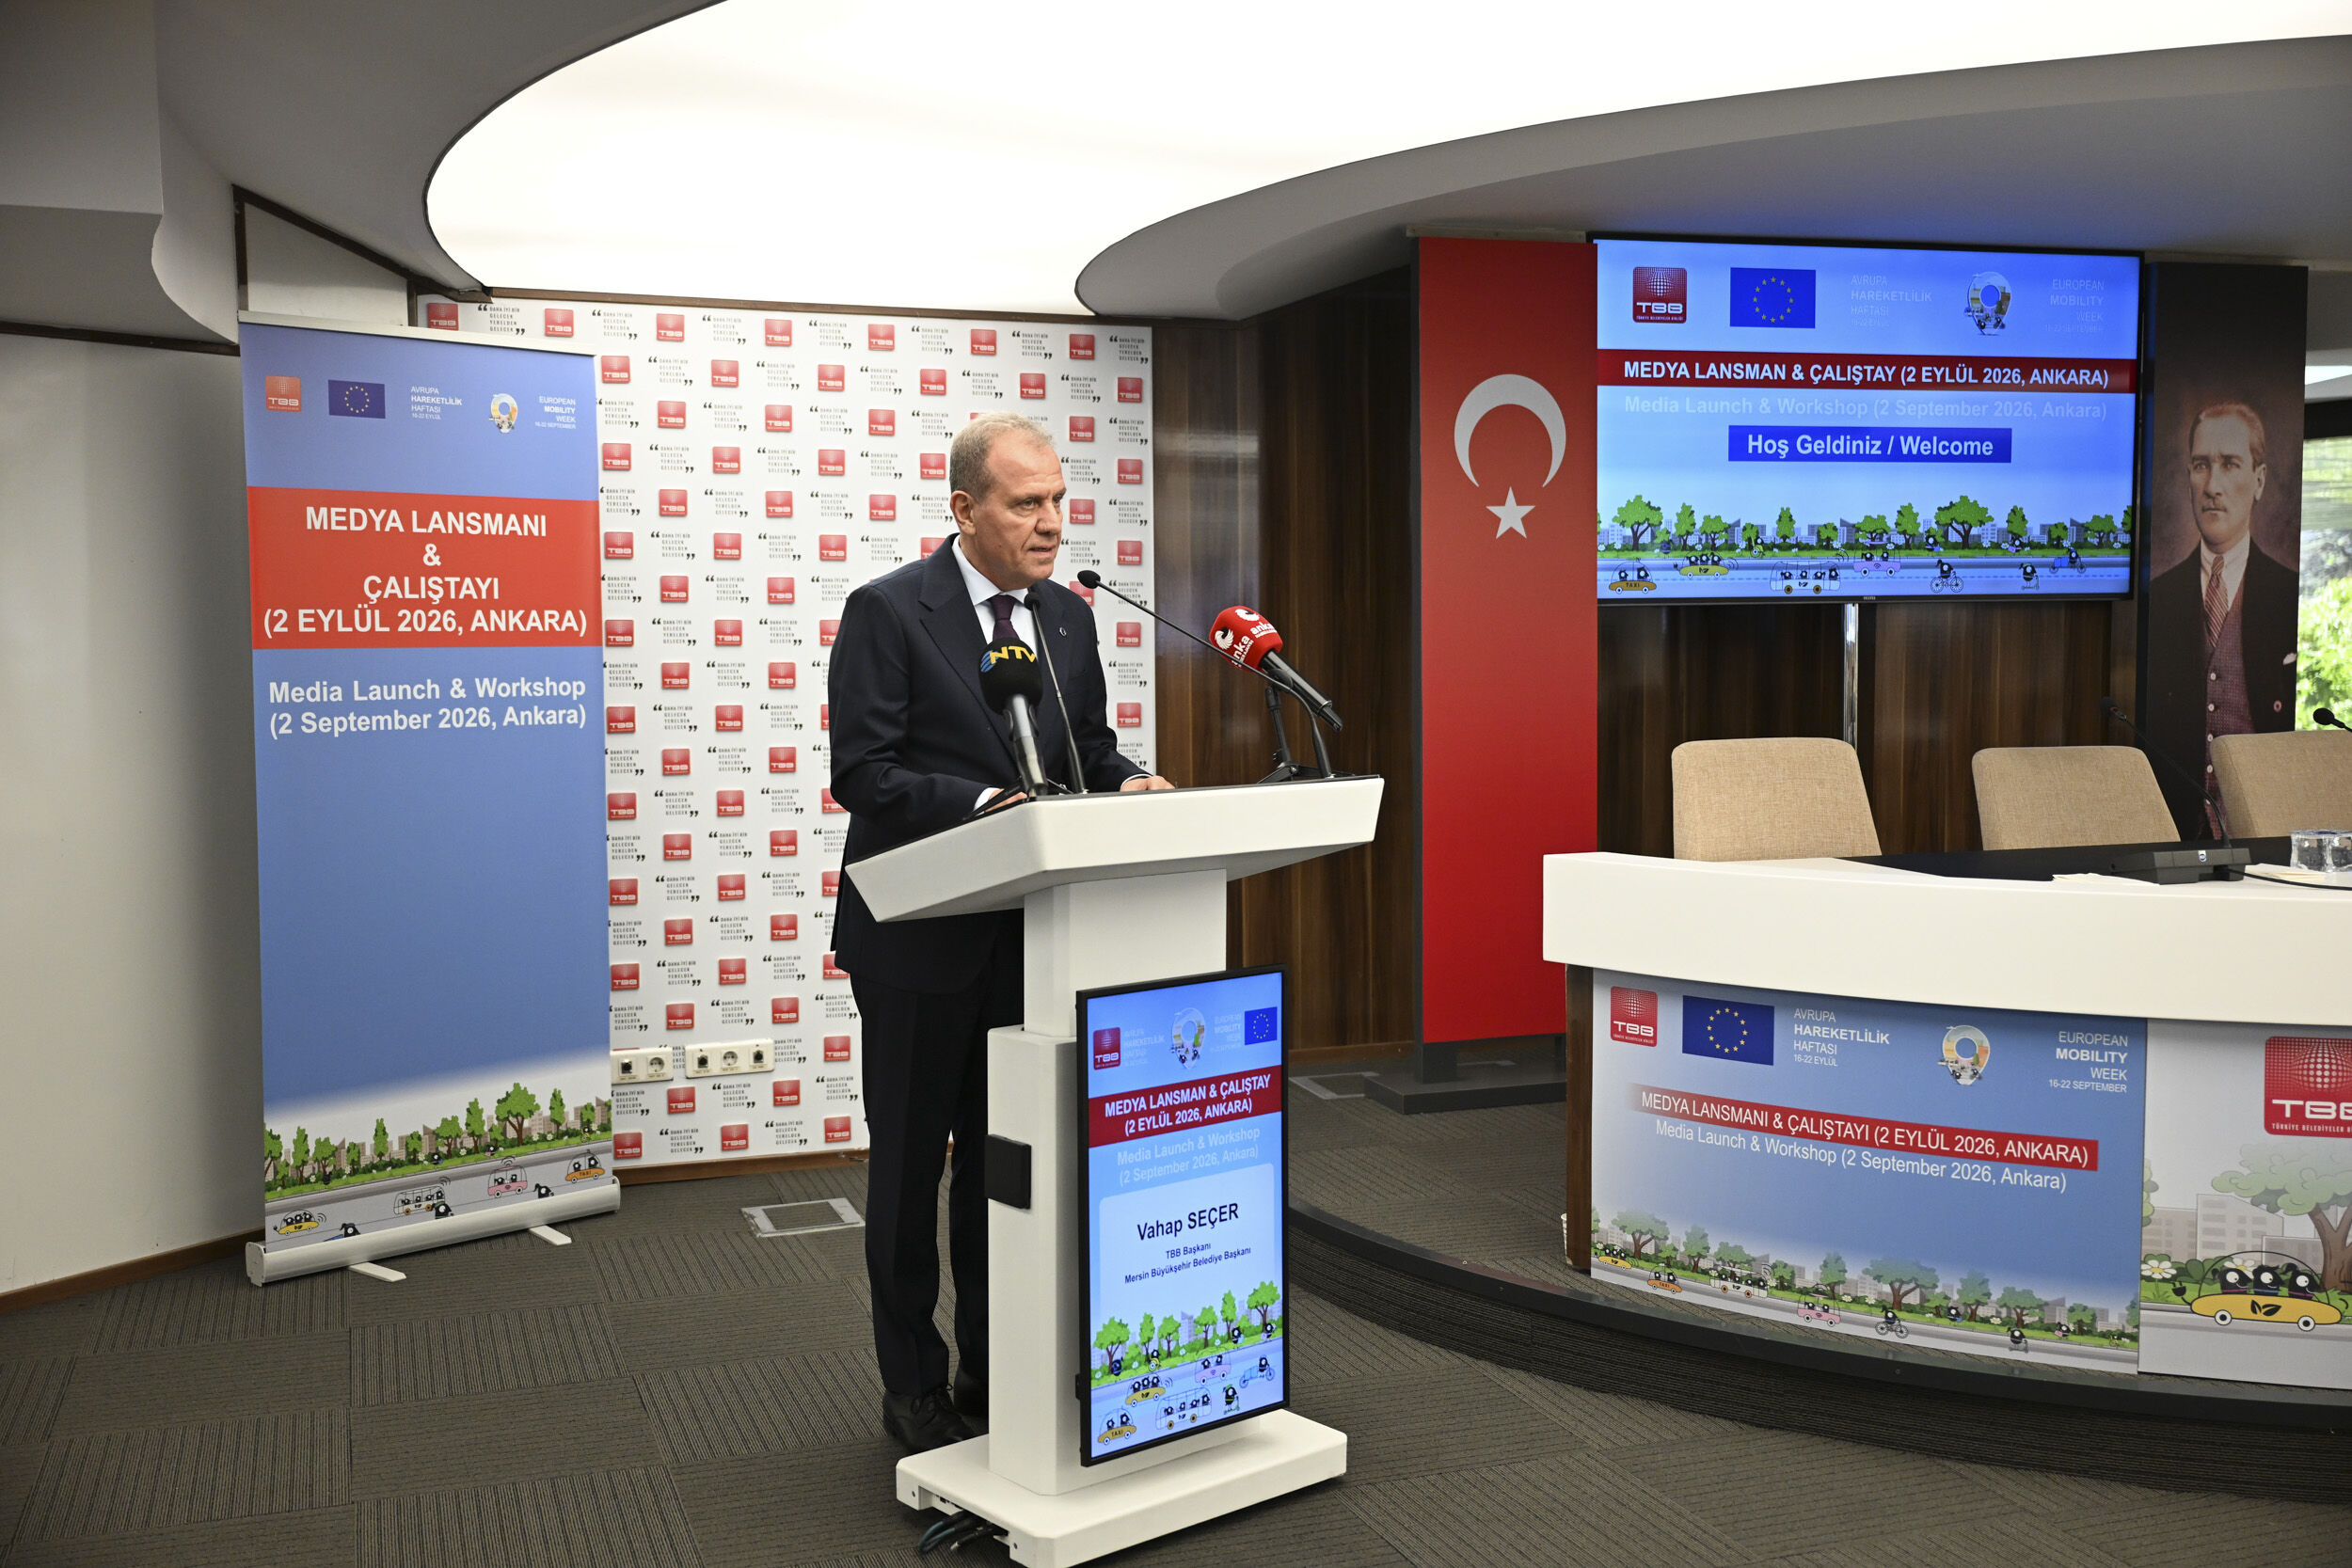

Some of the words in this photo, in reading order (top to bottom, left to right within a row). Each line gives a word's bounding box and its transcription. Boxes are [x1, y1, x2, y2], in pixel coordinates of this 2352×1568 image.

[2052, 278, 2105, 291] EUROPEAN
[1636, 302, 1683, 313] TBB
[2050, 294, 2104, 306] MOBILITY
[1624, 361, 1690, 379] MEDYA
[1694, 362, 1787, 380] LANSMAN
[1791, 364, 1804, 381] &
[1809, 365, 1897, 386] ÇALIŞTAY
[1900, 366, 1916, 386] (2
[1921, 363, 1979, 384] EYLÜL
[1982, 368, 2026, 387] 2026,
[2029, 369, 2109, 388] ANKARA)
[410, 387, 439, 395] AVRUPA
[268, 397, 299, 406] TBB
[411, 395, 462, 406] HAREKETLİLİK
[411, 404, 441, 413] HAFTASI
[539, 396, 576, 405] EUROPEAN
[544, 405, 576, 415] MOBILITY
[1625, 396, 1679, 413] Media
[1686, 397, 1753, 414] Launch
[1759, 398, 1772, 414] &
[1777, 398, 1867, 419] Workshop
[1874, 400, 1889, 420] (2
[1895, 400, 1989, 420] September
[1994, 401, 2037, 420] 2026,
[2042, 402, 2106, 422] Ankara)
[556, 415, 576, 423] WEEK
[1748, 434, 1788, 459] Hoş
[1796, 435, 1882, 454] Geldiniz
[1887, 436, 1894, 455] /
[1899, 436, 1994, 455] Welcome
[306, 507, 405, 533] MEDYA
[411, 511, 547, 537] LANSMANI
[422, 544, 442, 566] &
[363, 576, 500, 604] ÇALIŞTAYI
[263, 609, 289, 639] (2
[298, 604, 390, 633] EYLÜL
[397, 610, 464, 636] 2026,
[469, 610, 587, 637] ANKARA)
[990, 645, 1036, 665] NTV
[269, 681, 343, 704] Media
[353, 679, 440, 701] Launch
[450, 678, 467, 699] &
[475, 676, 586, 701] Workshop
[270, 712, 293, 740] (2
[300, 710, 432, 737] September
[438, 706, 497, 731] 2026,
[502, 705, 586, 729] Ankara)
[1794, 1007, 1836, 1023] AVRUPA
[1613, 1021, 1654, 1037] TBB
[1794, 1023, 1890, 1045] HAREKETLİLİK
[1794, 1039, 1837, 1055] HAFTASI
[2058, 1031, 2128, 1047] EUROPEAN
[1095, 1052, 1120, 1063] TBB
[1793, 1053, 1812, 1064] 16-22
[1814, 1054, 1837, 1067] EYLÜL
[2056, 1048, 2128, 1064] MOBILITY
[2090, 1067, 2128, 1081] WEEK
[2049, 1079, 2071, 1089] 16-22
[2073, 1080, 2127, 1093] SEPTEMBER
[1104, 1097, 1147, 1117] MEDYA
[1150, 1085, 1206, 1110] LANSMAN
[1209, 1084, 1217, 1099] &
[1220, 1073, 1271, 1100] ÇALIŞTAY
[1124, 1119, 1136, 1136] (2
[1137, 1111, 1173, 1132] EYLÜL
[1175, 1109, 1202, 1125] 2026,
[1204, 1098, 1253, 1119] ANKARA)
[1642, 1091, 1690, 1115] MEDYA
[1692, 1101, 1769, 1128] LANSMANI
[1773, 1113, 1784, 1130] &
[1788, 1115, 1869, 1141] ÇALIŞTAYI
[1874, 1127, 1889, 1147] (2
[1894, 1128, 1950, 1151] EYLÜL
[1954, 1135, 2000, 1158] 2026,
[2004, 1140, 2089, 1168] ANKARA)
[2302, 1124, 2344, 1132] BELEDİYELER
[1117, 1147, 1152, 1166] Media
[1154, 1139, 1194, 1159] Launch
[1198, 1135, 1205, 1150] &
[1208, 1127, 1261, 1148] Workshop
[1656, 1119, 1693, 1141] Media
[1698, 1127, 1746, 1150] Launch
[1750, 1135, 1761, 1152] &
[1764, 1137, 1837, 1167] Workshop
[1841, 1148, 1856, 1169] (2
[1861, 1151, 1947, 1178] September
[1951, 1163, 1996, 1186] 2026,
[2001, 1167, 2067, 1194] Ankara)
[1120, 1170, 1130, 1187] (2
[1133, 1161, 1190, 1182] September
[1193, 1152, 1220, 1169] 2026,
[1222, 1145, 1259, 1163] Ankara)
[1136, 1219, 1184, 1241] Vahap
[1187, 1202, 1239, 1229] SEÇER
[1166, 1248, 1182, 1259] TBB
[1183, 1242, 1212, 1256] Başkanı
[1124, 1271, 1150, 1284] Mersin
[1151, 1260, 1191, 1278] Büyükşehir
[1193, 1252, 1222, 1268] Belediye
[1224, 1246, 1251, 1260] Başkanı
